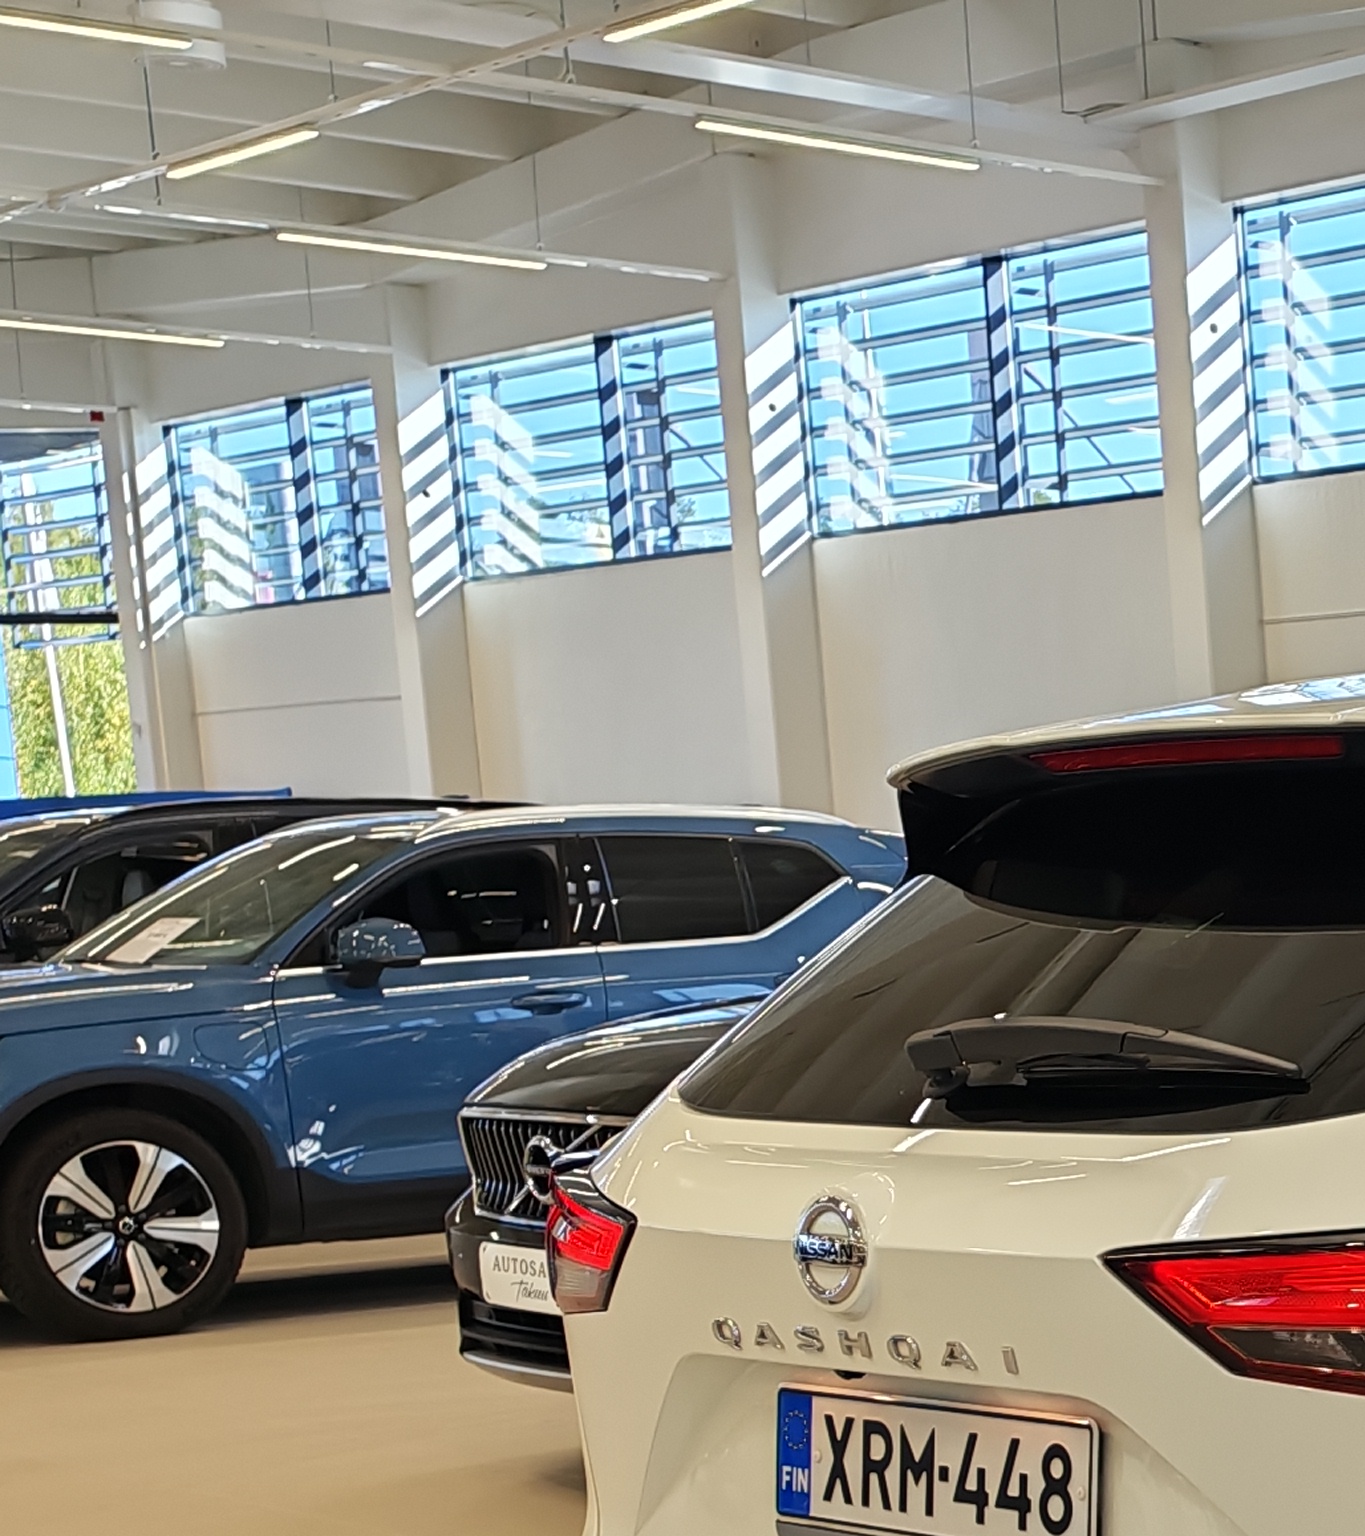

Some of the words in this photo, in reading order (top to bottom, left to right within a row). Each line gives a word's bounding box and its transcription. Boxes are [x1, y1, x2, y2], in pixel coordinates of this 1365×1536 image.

[711, 1316, 1020, 1375] QASHQAI
[781, 1465, 809, 1495] FIN
[821, 1413, 1074, 1536] XRM-448
